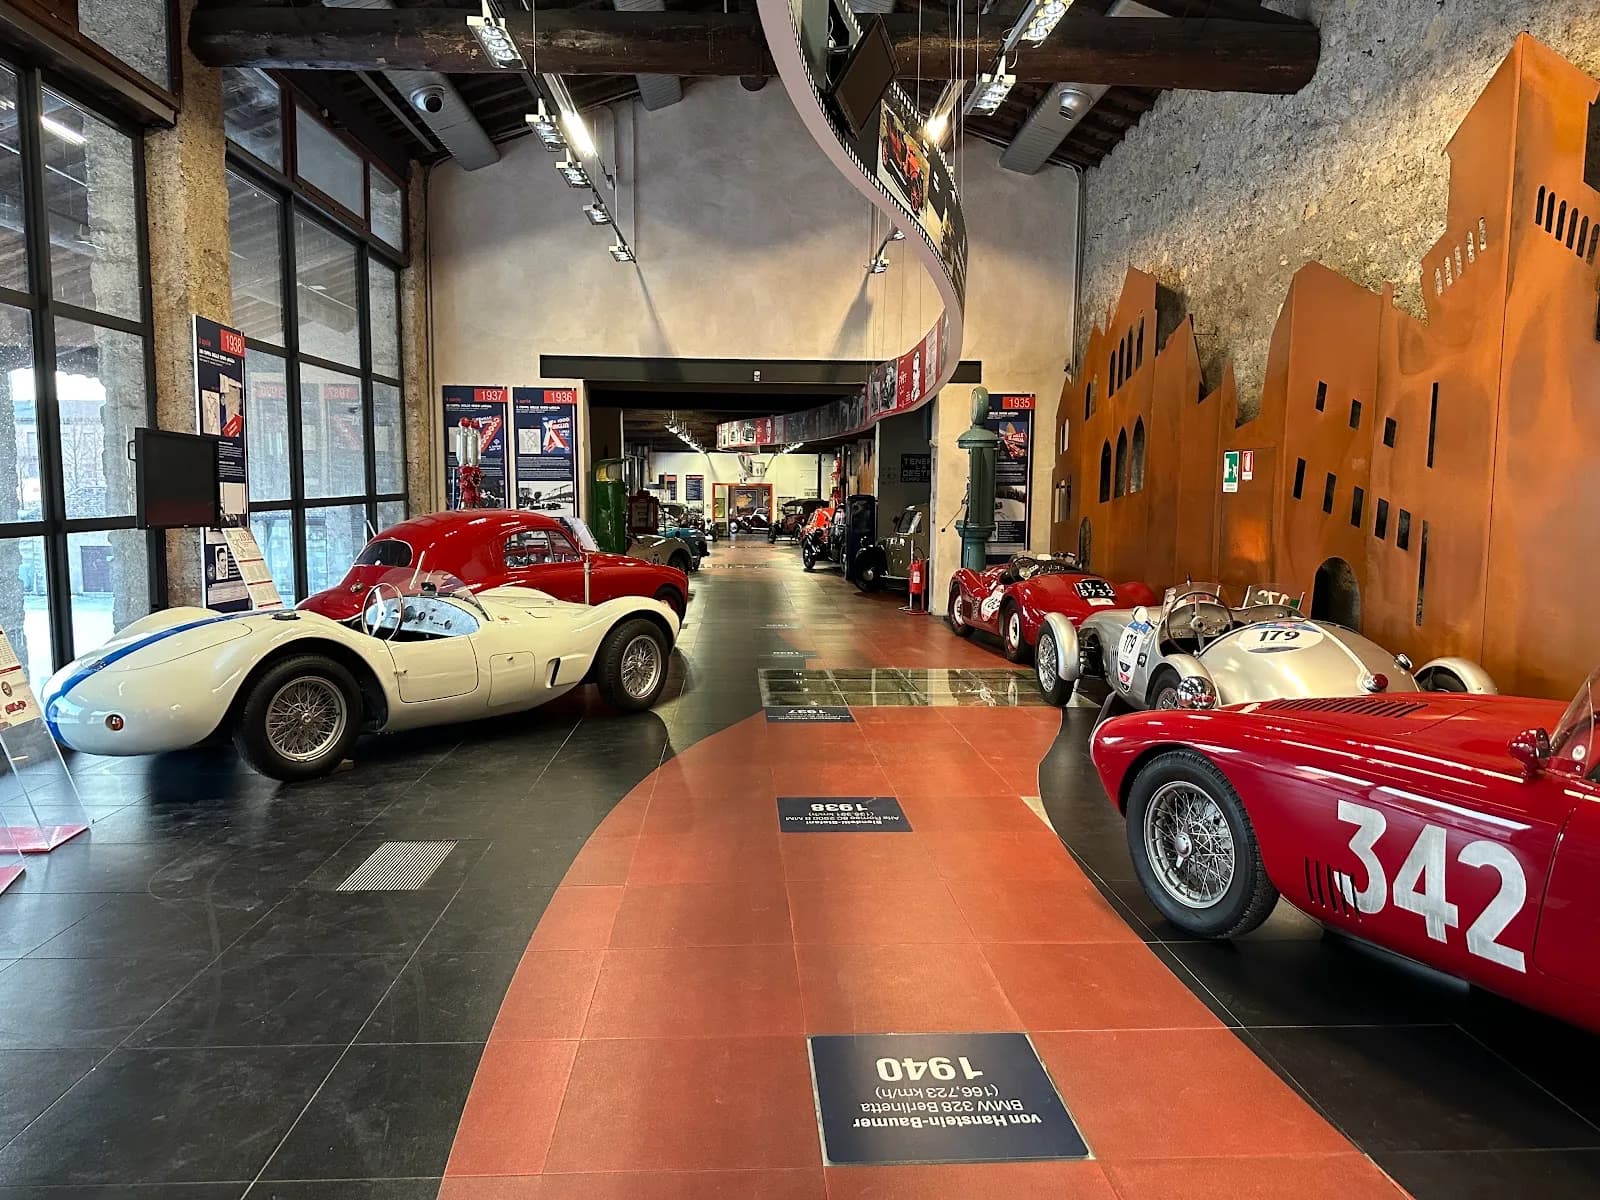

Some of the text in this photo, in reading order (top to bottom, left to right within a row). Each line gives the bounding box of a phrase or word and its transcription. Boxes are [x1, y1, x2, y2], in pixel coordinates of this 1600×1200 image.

[225, 335, 242, 354] 1938
[481, 390, 503, 401] 1937
[551, 391, 573, 402] 1936
[1008, 397, 1031, 408] 1935
[1080, 589, 1116, 597] 8732
[1123, 632, 1138, 655] 179
[1260, 630, 1301, 642] 179
[810, 803, 869, 812] 1938
[1333, 799, 1527, 974] 342
[876, 1056, 984, 1082] 1940
[875, 1083, 999, 1100] (166,723 km/h)
[860, 1099, 1024, 1114] BMW 328 Berlinetta
[852, 1113, 1042, 1129] von Hanstein-Baumer
